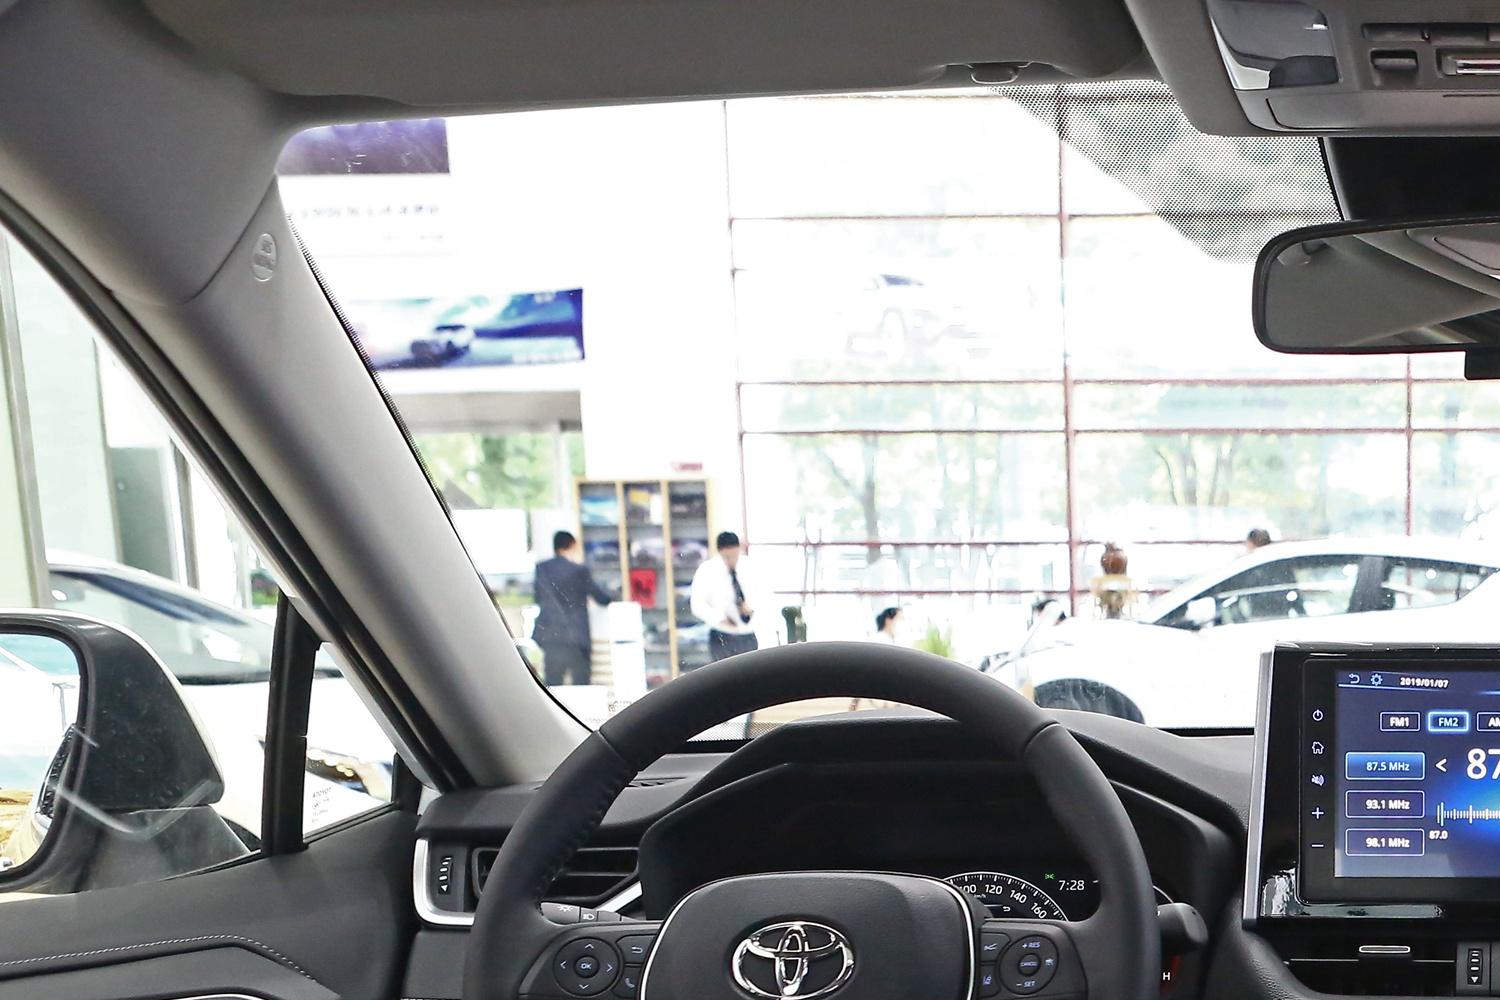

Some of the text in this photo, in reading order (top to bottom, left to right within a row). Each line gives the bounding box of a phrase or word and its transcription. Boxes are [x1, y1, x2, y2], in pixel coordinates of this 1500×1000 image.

[1400, 677, 1449, 689] 2019/01/07
[1389, 717, 1410, 727] FM1
[1438, 717, 1459, 727] FM2
[1366, 762, 1410, 771] 87.5 MHz
[1365, 799, 1410, 810] 93.1 MHz
[1428, 830, 1449, 840] 87.0
[1366, 837, 1410, 848] 98.1 MHz
[960, 884, 977, 894] 00
[984, 884, 1003, 895] 120
[1059, 880, 1085, 891] 7:28
[1009, 889, 1027, 904] 140
[1030, 902, 1048, 919] 160
[1162, 971, 1171, 981] H
